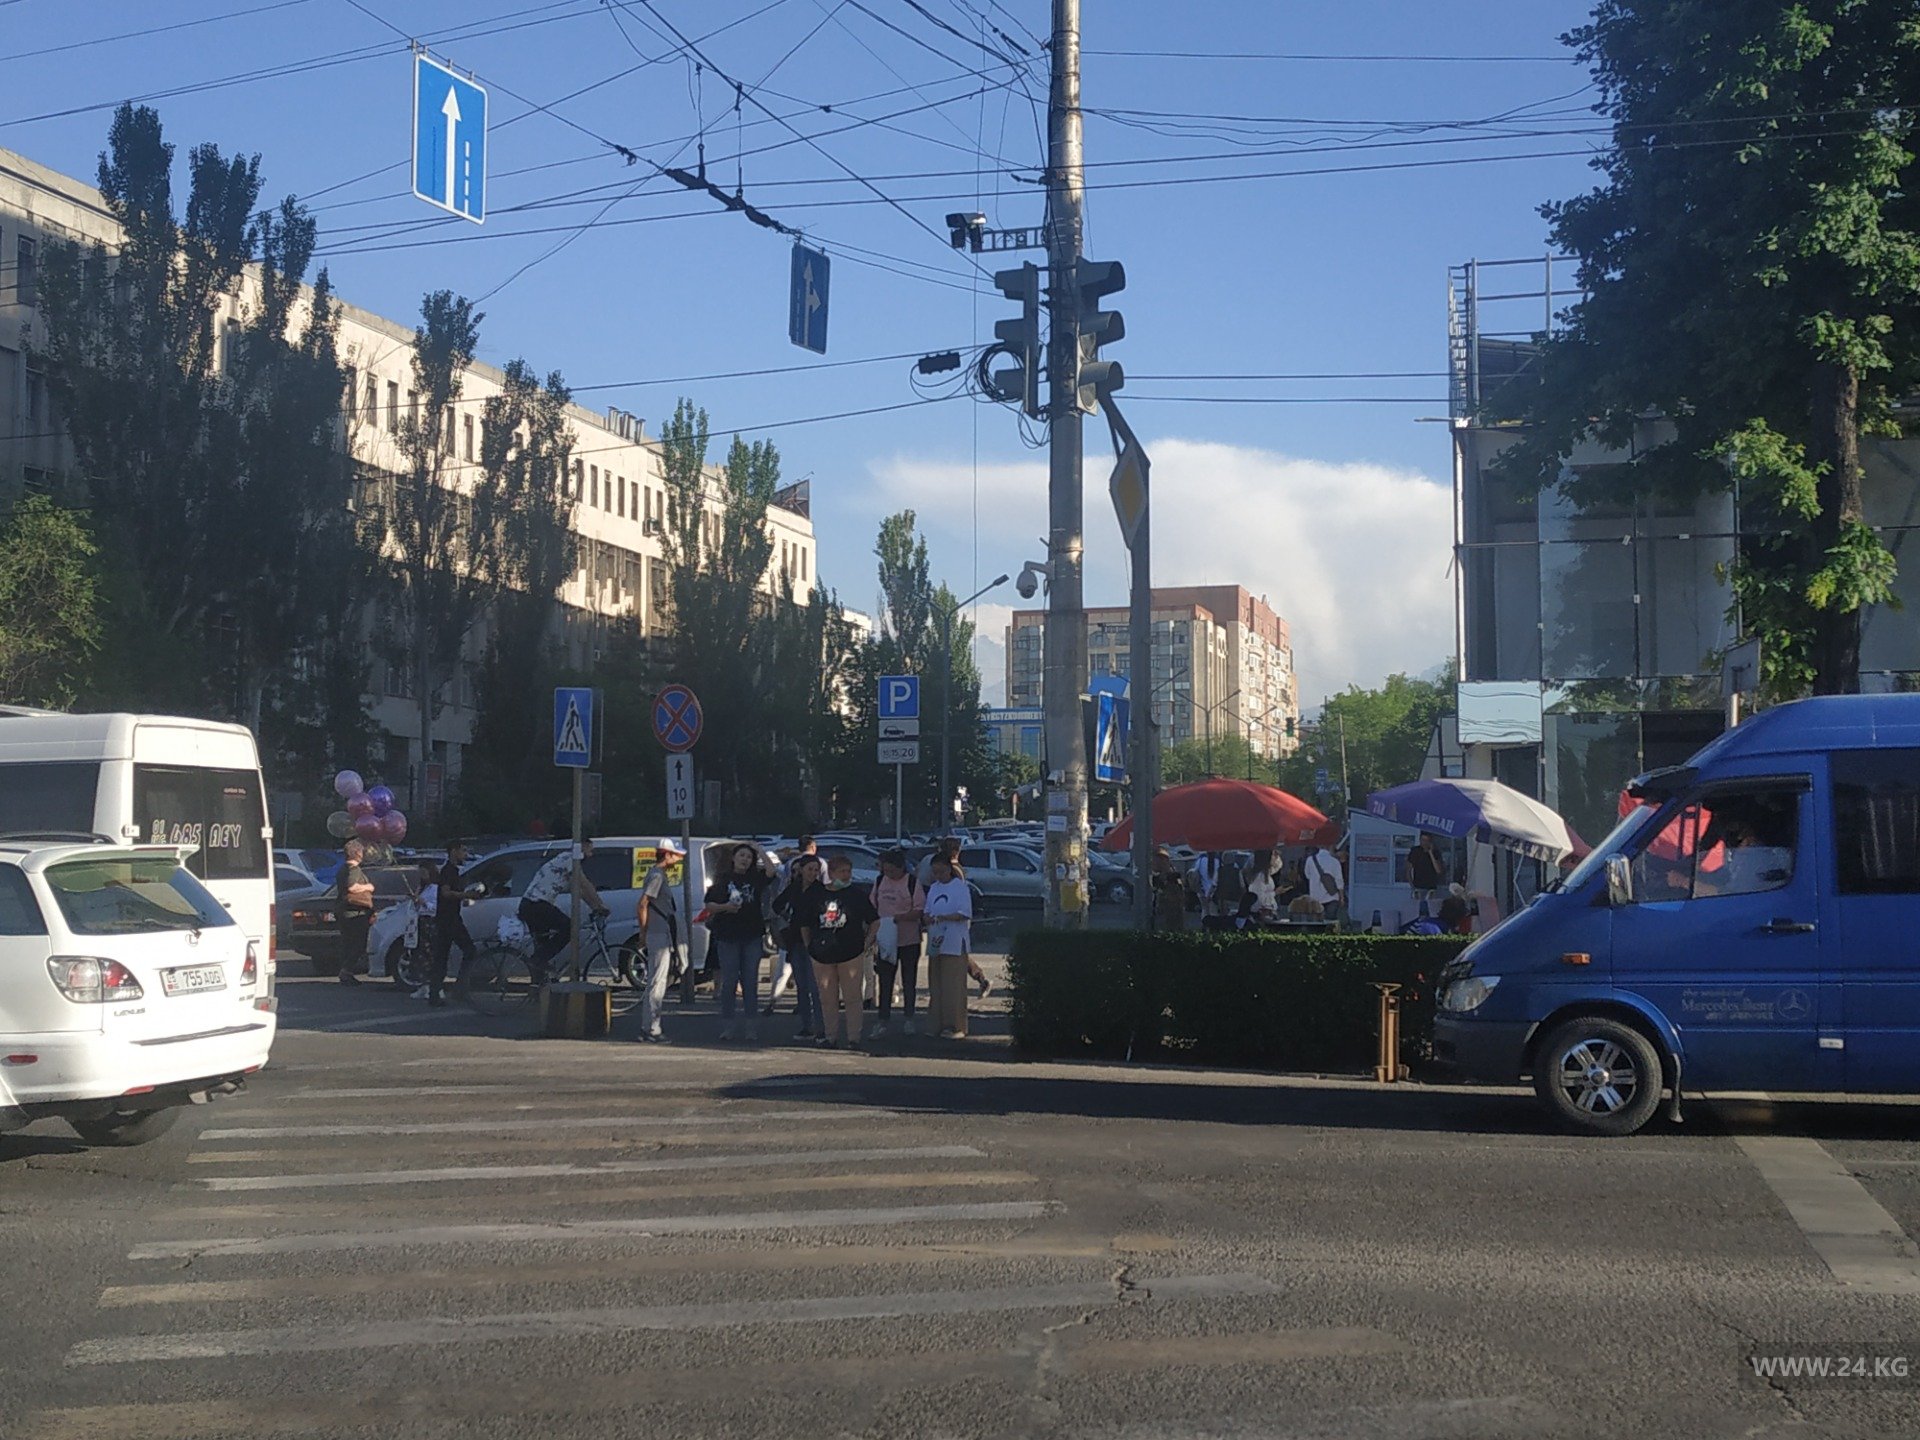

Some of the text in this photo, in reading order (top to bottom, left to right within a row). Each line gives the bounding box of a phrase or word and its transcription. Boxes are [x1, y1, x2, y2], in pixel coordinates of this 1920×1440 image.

[890, 681, 911, 713] P
[902, 748, 914, 757] 20
[673, 787, 687, 801] 10
[1414, 810, 1456, 834] АРШАН
[182, 969, 203, 988] 755
